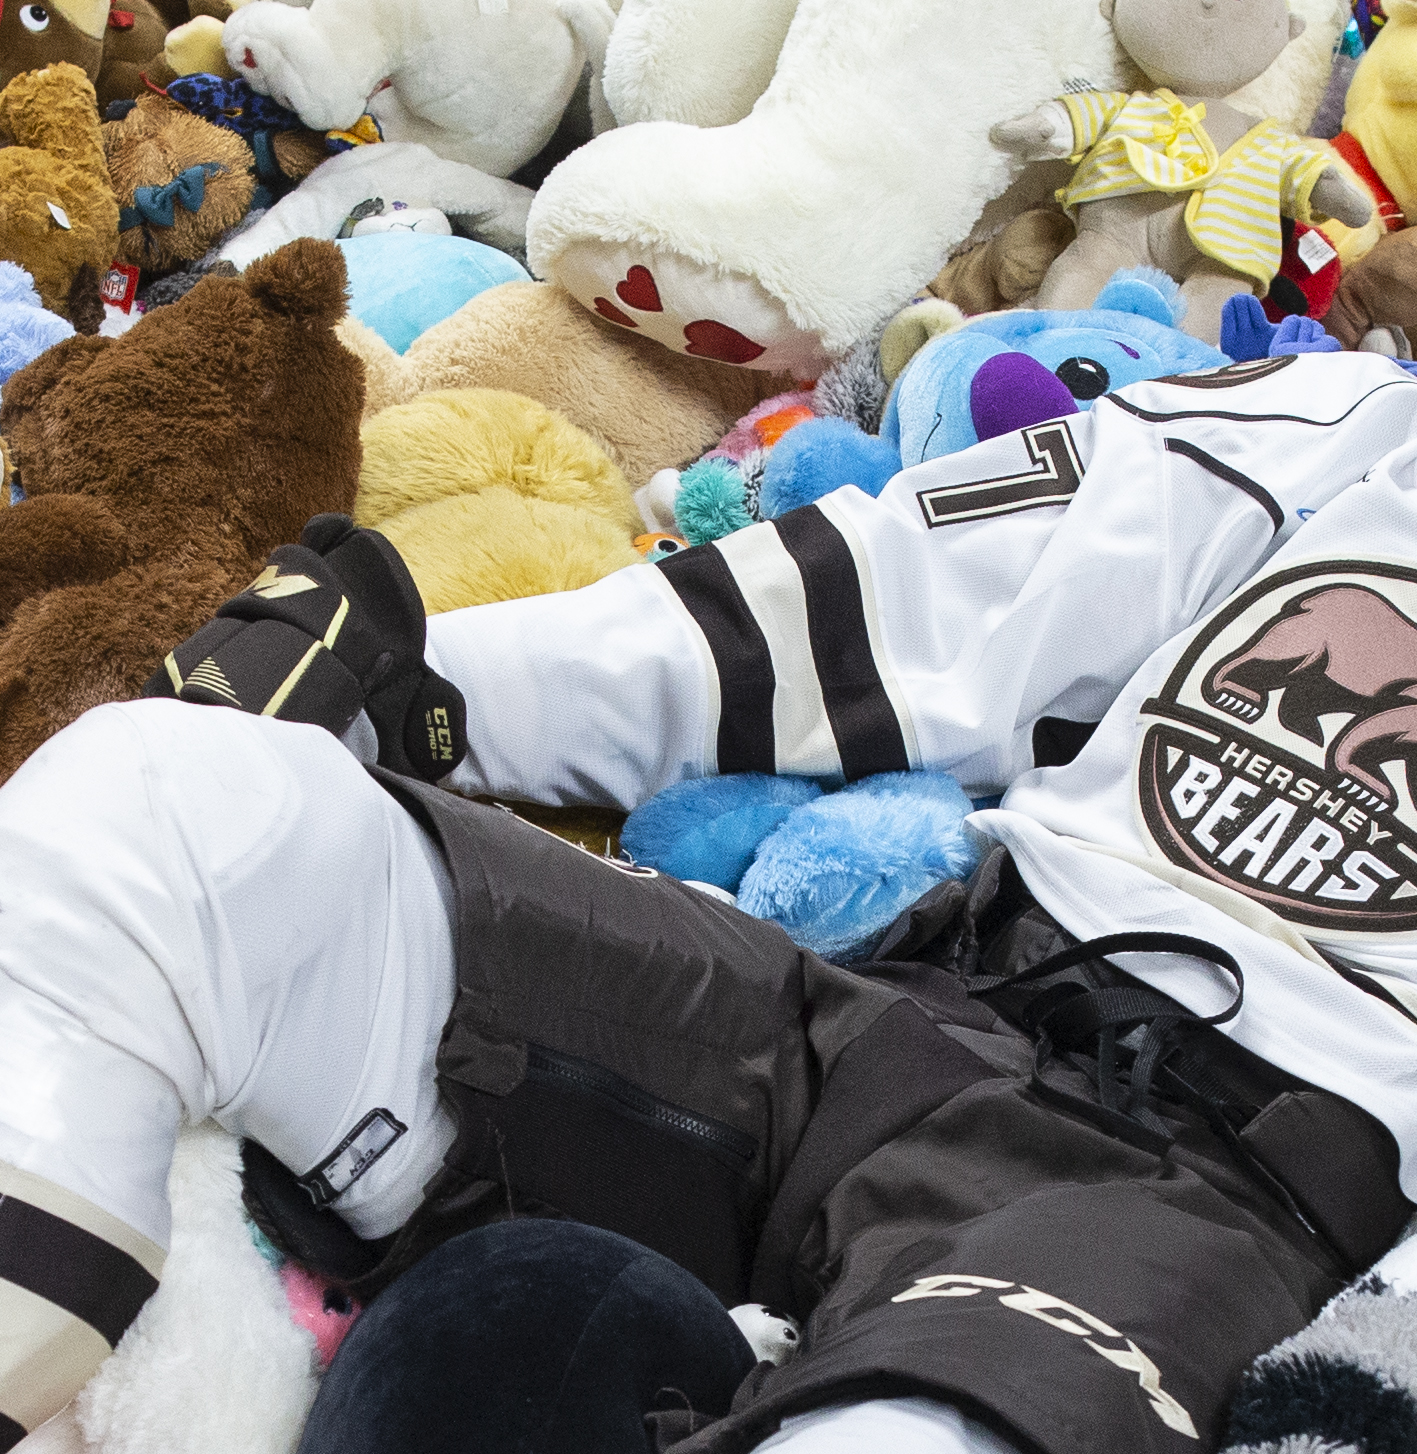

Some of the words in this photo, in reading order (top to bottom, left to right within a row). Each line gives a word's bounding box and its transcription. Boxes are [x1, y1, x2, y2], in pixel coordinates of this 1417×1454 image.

[433, 706, 453, 760] CCM
[1220, 742, 1392, 845] HERSHEY
[1170, 754, 1400, 902] BEARS
[891, 1274, 1200, 1439] CCM
